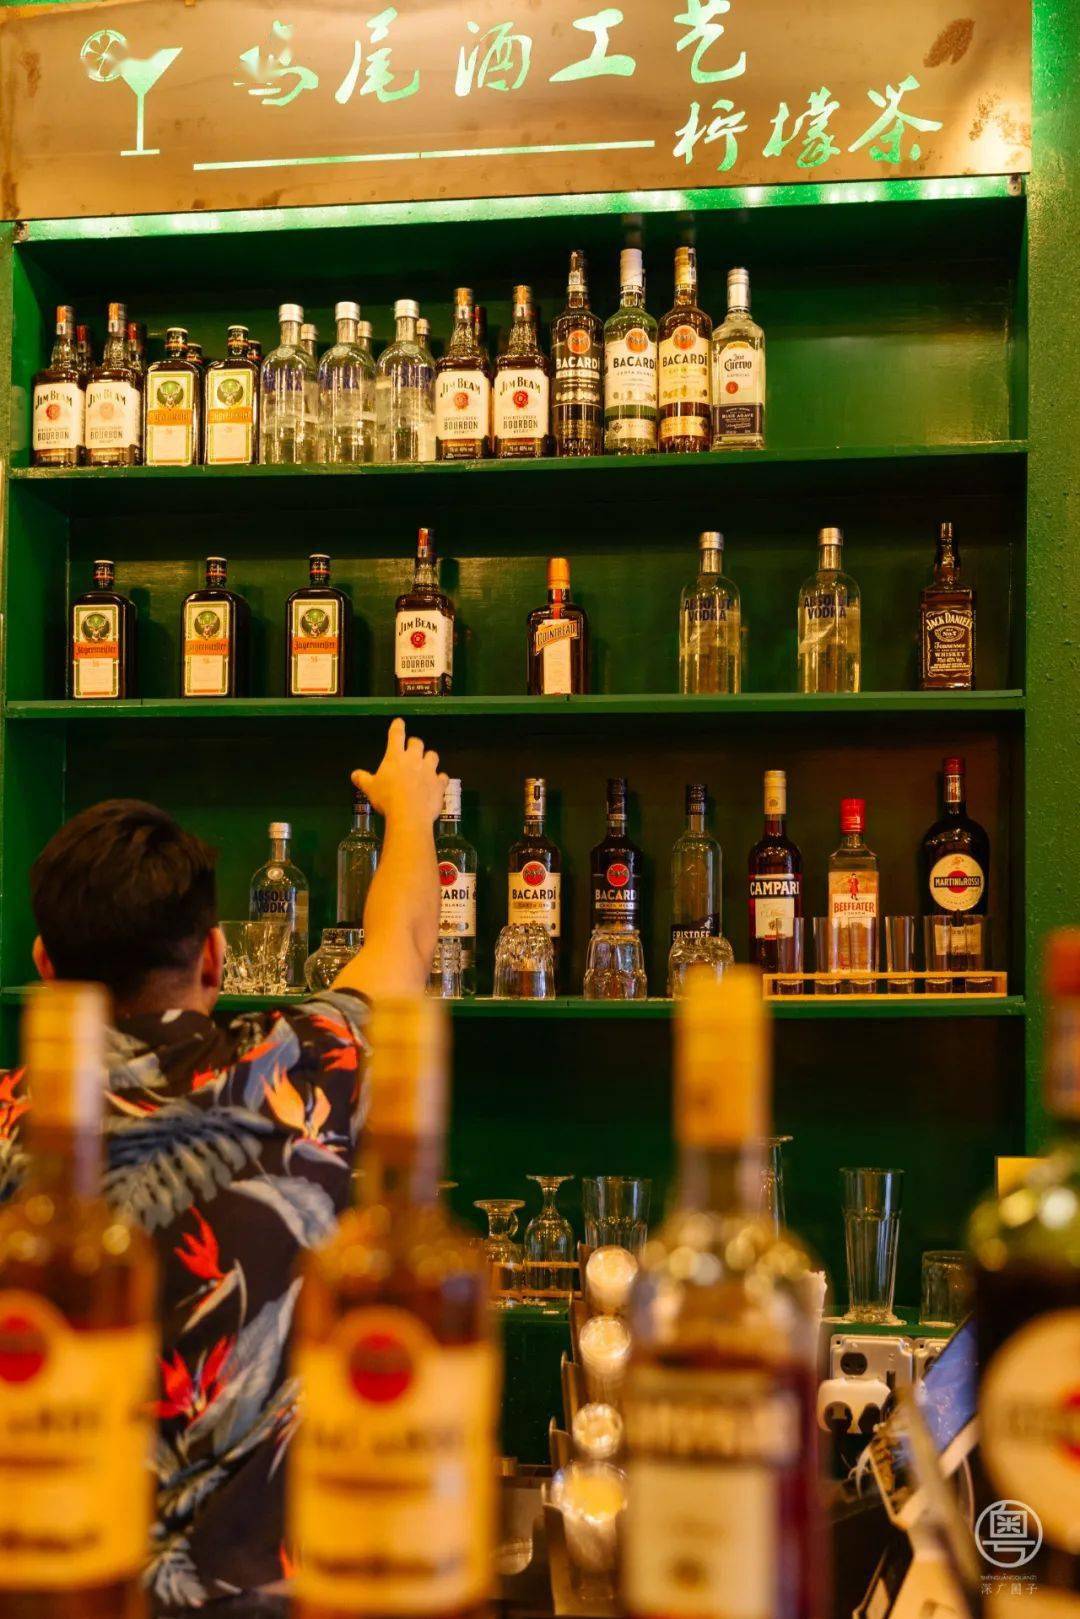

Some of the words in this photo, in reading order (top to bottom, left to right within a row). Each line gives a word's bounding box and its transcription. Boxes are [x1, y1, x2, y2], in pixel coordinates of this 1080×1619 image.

[673, 75, 943, 171] 柠檬茶
[724, 359, 752, 371] Cuervo
[440, 382, 455, 397] JIM
[457, 378, 481, 395] BEAM
[500, 380, 515, 396] JIM
[517, 376, 541, 393] BEAM
[35, 394, 49, 410] JIM
[88, 393, 101, 408] JIM
[444, 421, 478, 431] BOURBON
[503, 420, 538, 429] BOURBON
[37, 431, 70, 442] BOURBON
[91, 431, 123, 440] BOURBON
[688, 609, 727, 621] VODKA
[808, 607, 846, 619] VODKA
[399, 621, 413, 636] JIM
[415, 617, 437, 633] BEAM
[926, 615, 945, 630] JACK
[401, 659, 435, 669] BOURBON
[750, 881, 800, 896] CAMPARI
[833, 902, 874, 913] BEEFEATER
